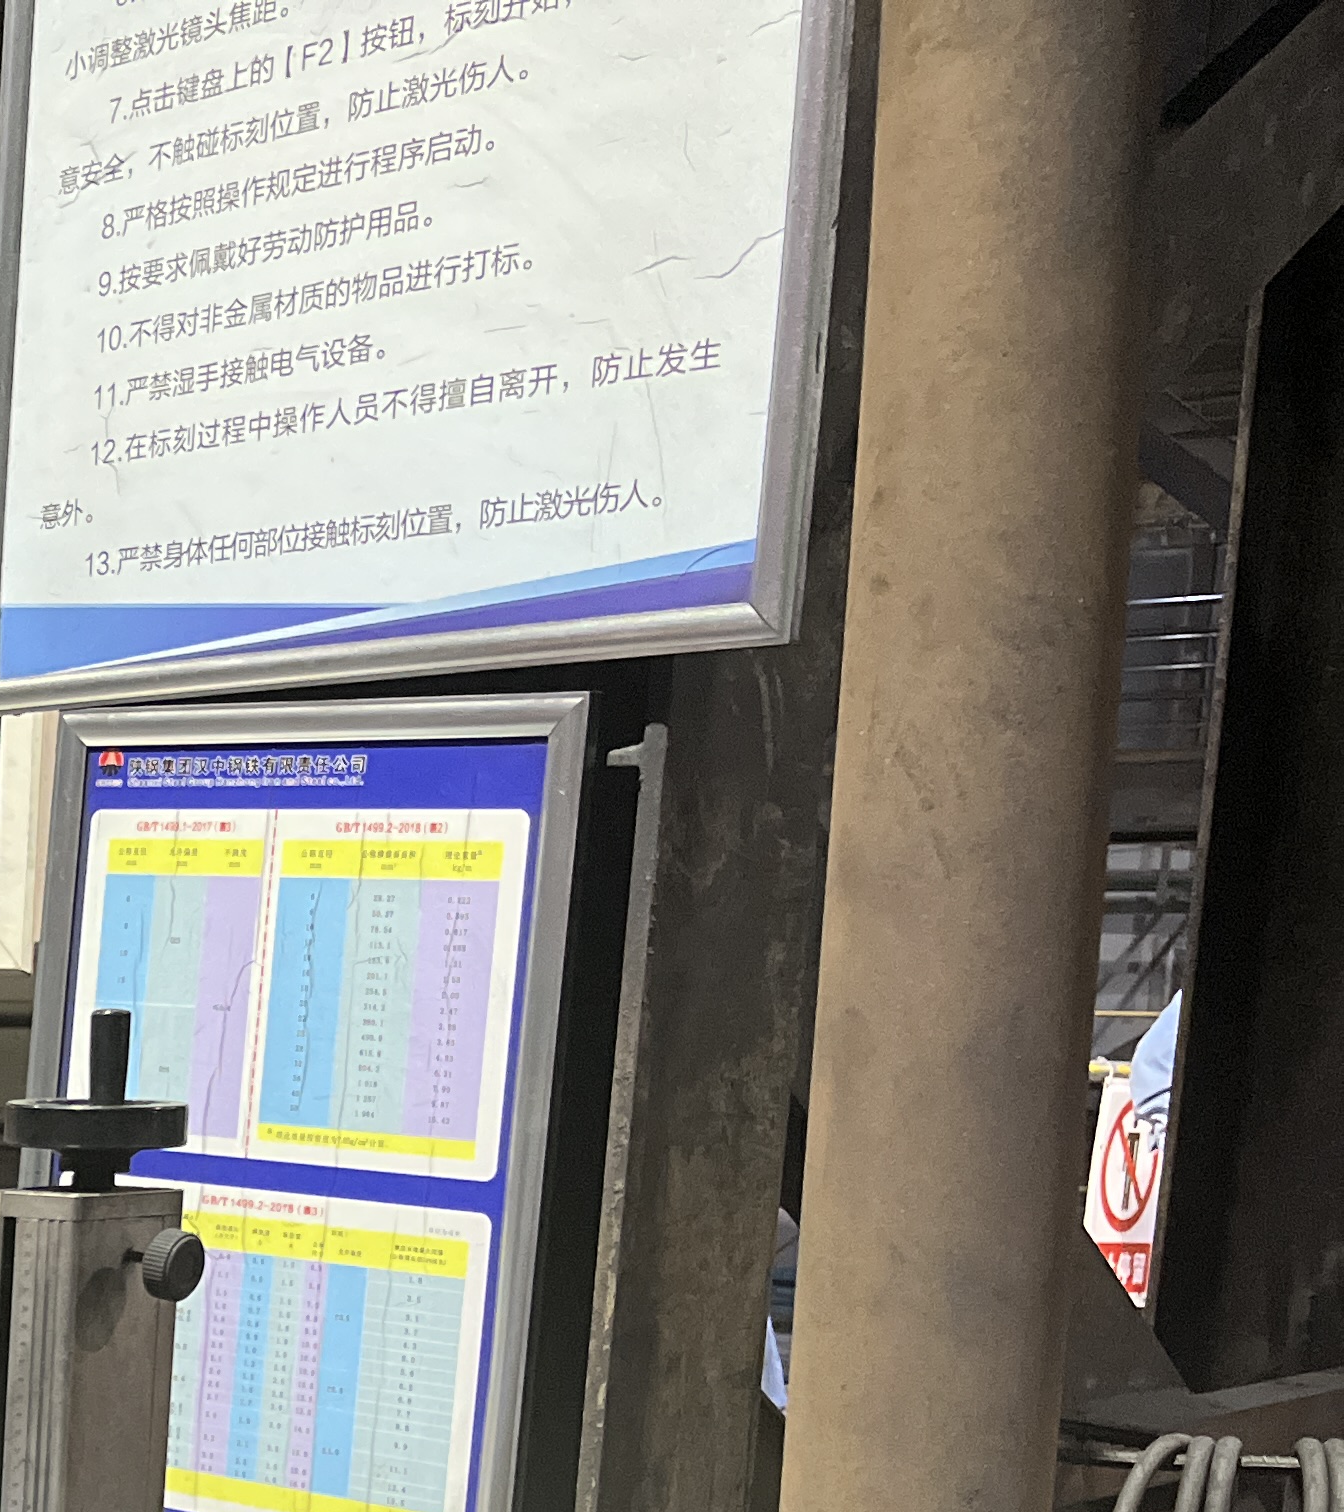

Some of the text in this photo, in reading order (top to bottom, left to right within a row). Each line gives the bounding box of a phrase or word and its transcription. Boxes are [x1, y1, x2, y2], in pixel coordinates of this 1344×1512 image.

[58, 54, 531, 196] 意安全，不触碰标刻位置，防止激光伤人。
[101, 125, 497, 241] 8.严格按照操作规定进行程序启动。
[98, 202, 434, 298] 9.按要求佩戴好劳动防护用品。
[96, 243, 534, 355] 10.不得对非金属材质的物品进行打标。
[90, 339, 723, 467] 12.在标刻过程中操作人员不得擅自离开，防止发生
[93, 333, 388, 411] 11.严禁湿手接触电气设备。
[38, 503, 96, 531] 意外。
[85, 482, 666, 578] 13.严禁身体任何部位接触标刻位置，防止激光伤人。
[128, 754, 368, 777] 陕钢集团汉中钢铁有限责任公司
